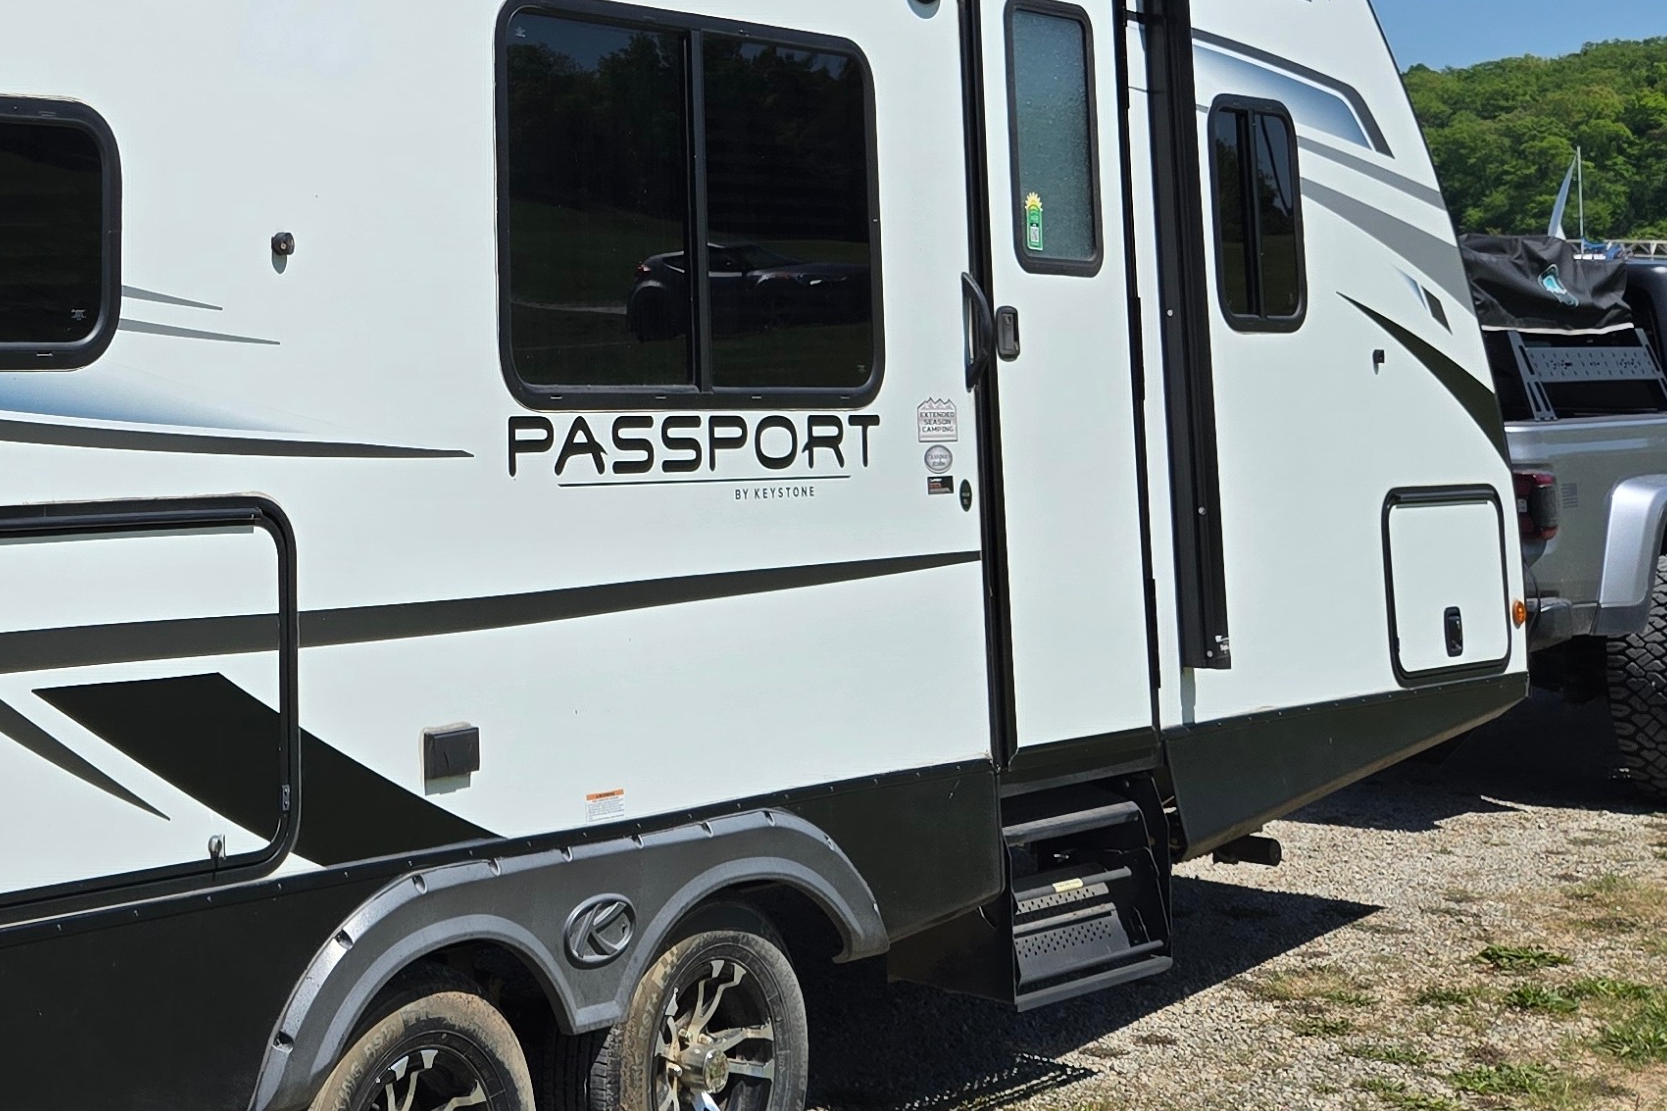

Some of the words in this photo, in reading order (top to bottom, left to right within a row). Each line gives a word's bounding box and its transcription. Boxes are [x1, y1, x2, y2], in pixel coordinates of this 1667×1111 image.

[508, 415, 880, 477] PASSPORT
[735, 489, 748, 499] BY
[754, 486, 814, 499] KEYSTONE
